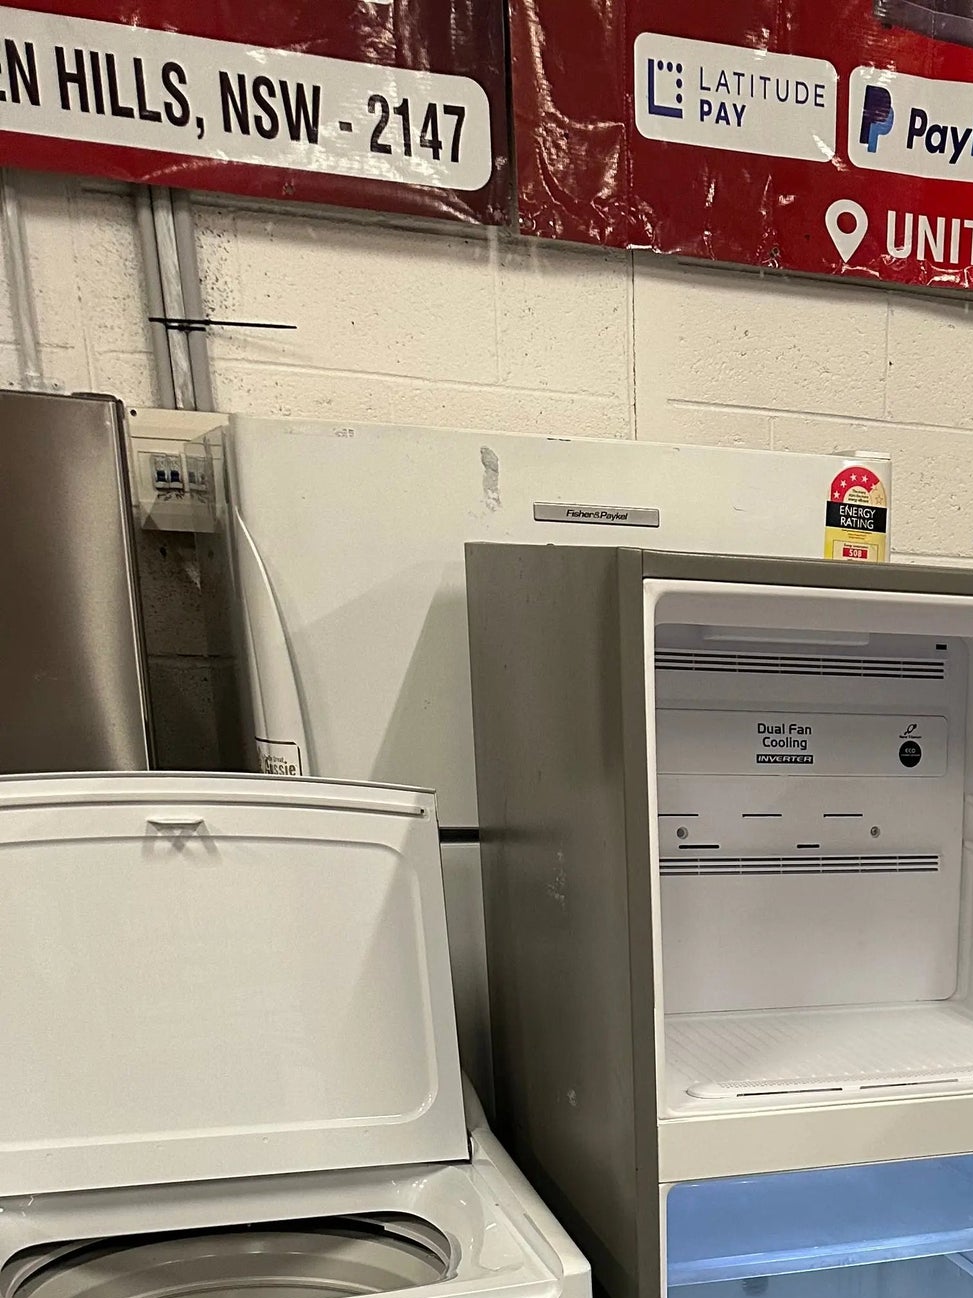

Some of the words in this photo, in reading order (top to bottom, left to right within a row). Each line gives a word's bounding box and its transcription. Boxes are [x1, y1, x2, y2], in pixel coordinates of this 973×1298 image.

[700, 66, 826, 107] LATITUDE
[55, 46, 206, 139] HILLS,
[219, 70, 321, 144] NSW
[338, 121, 353, 131] -
[367, 94, 466, 163] 2147
[699, 99, 747, 127] PAY
[840, 506, 876, 518] ENERGY
[841, 517, 874, 529] RATING
[757, 723, 785, 735] Dual
[788, 724, 812, 735] Fan
[762, 736, 807, 750] Cooling
[758, 755, 813, 764] INVERTER
